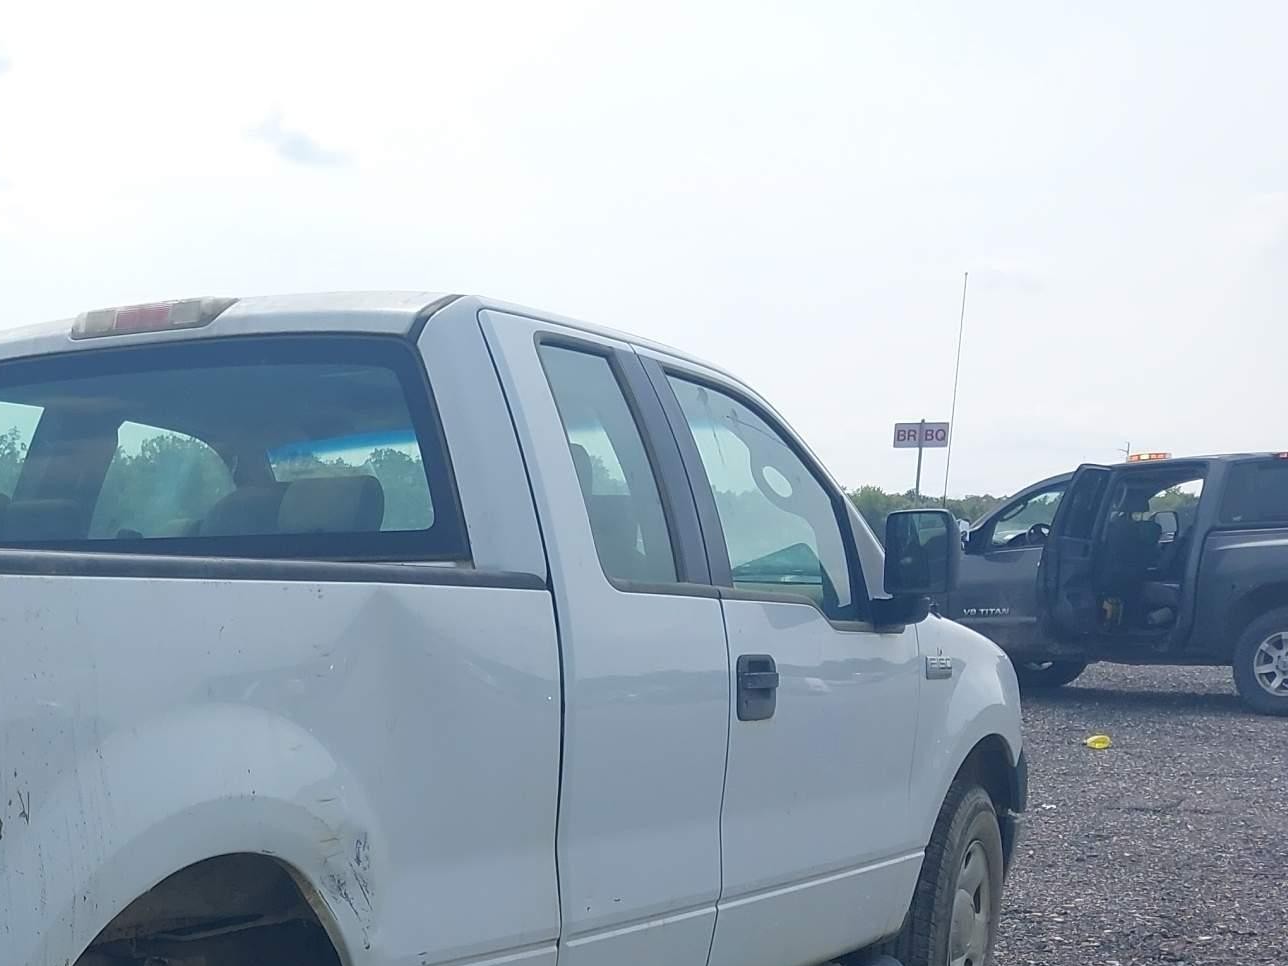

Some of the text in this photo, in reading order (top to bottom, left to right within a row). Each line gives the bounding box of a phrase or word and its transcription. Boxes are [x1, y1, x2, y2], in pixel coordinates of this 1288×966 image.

[896, 428, 947, 442] BR BQ
[979, 607, 1010, 616] TITAN
